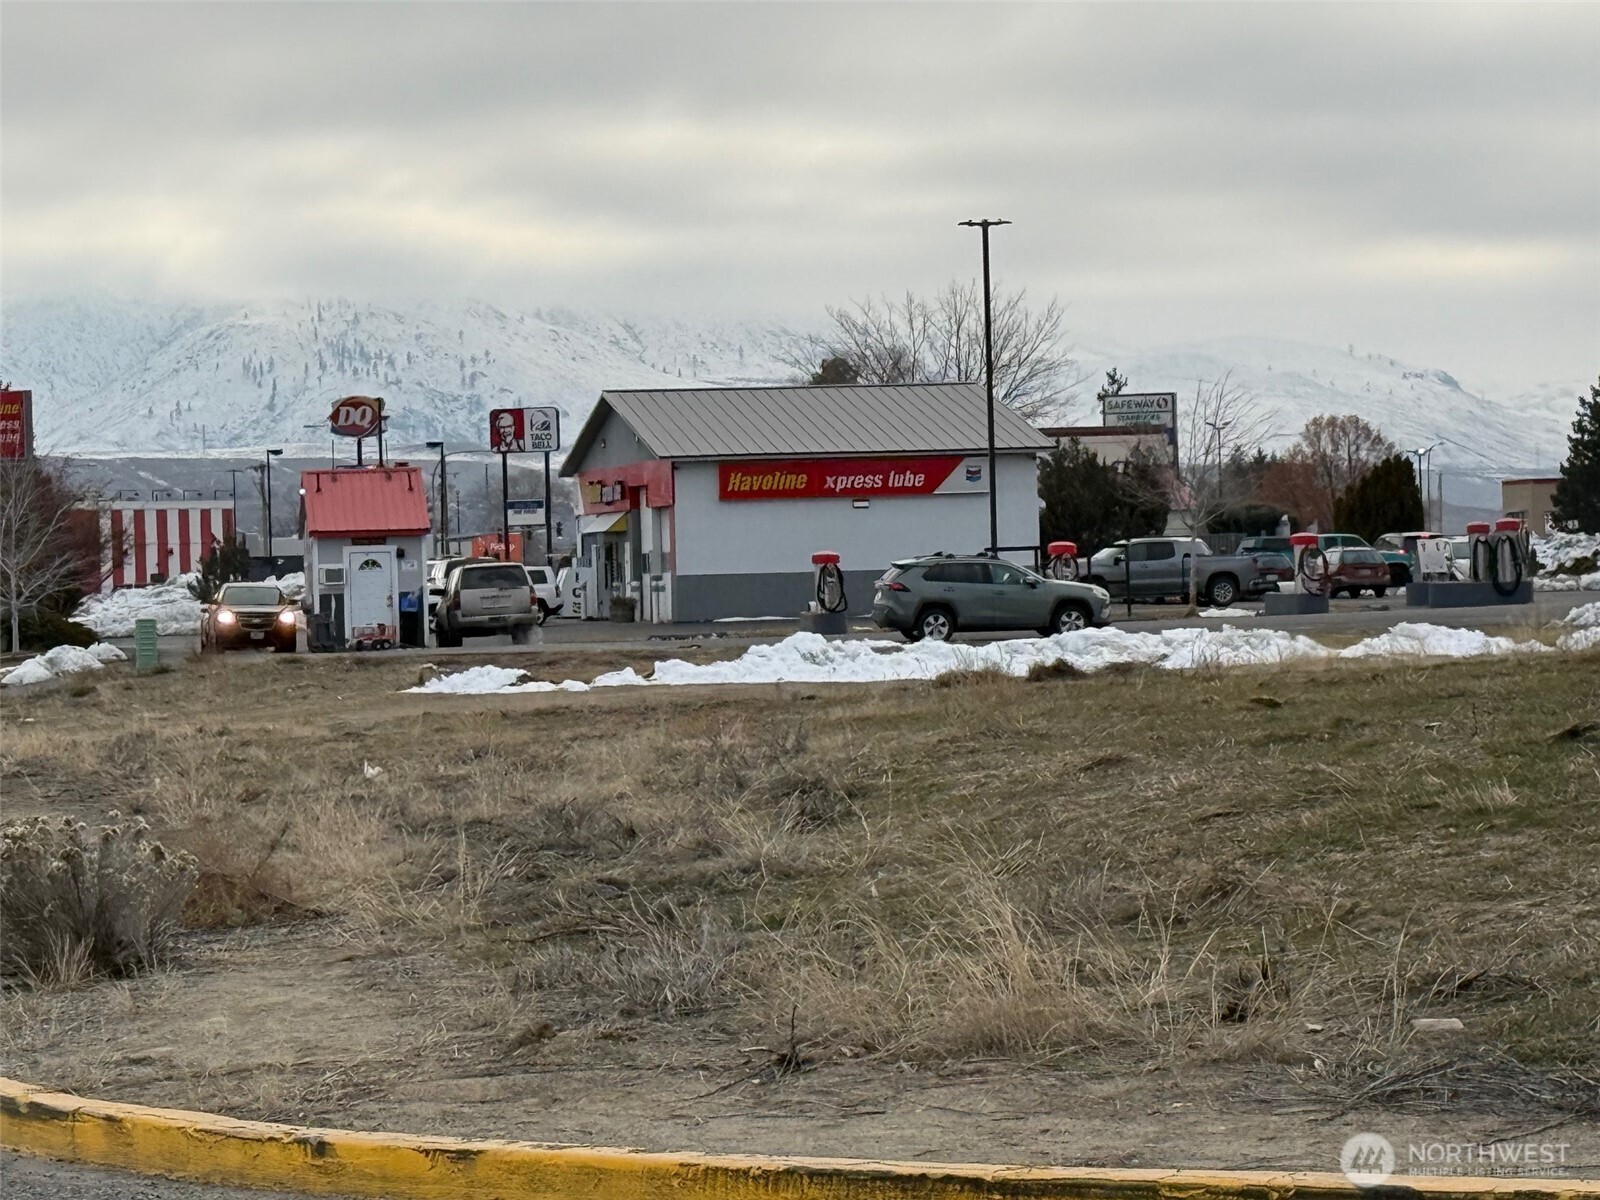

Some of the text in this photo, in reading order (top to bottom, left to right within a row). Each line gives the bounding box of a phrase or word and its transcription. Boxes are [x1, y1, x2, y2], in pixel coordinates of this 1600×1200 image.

[1107, 398, 1155, 410] SAFEWAY
[338, 406, 373, 428] DQ
[530, 433, 552, 441] TACO
[532, 441, 552, 449] BELL
[727, 470, 926, 493] Havoline xpress lube
